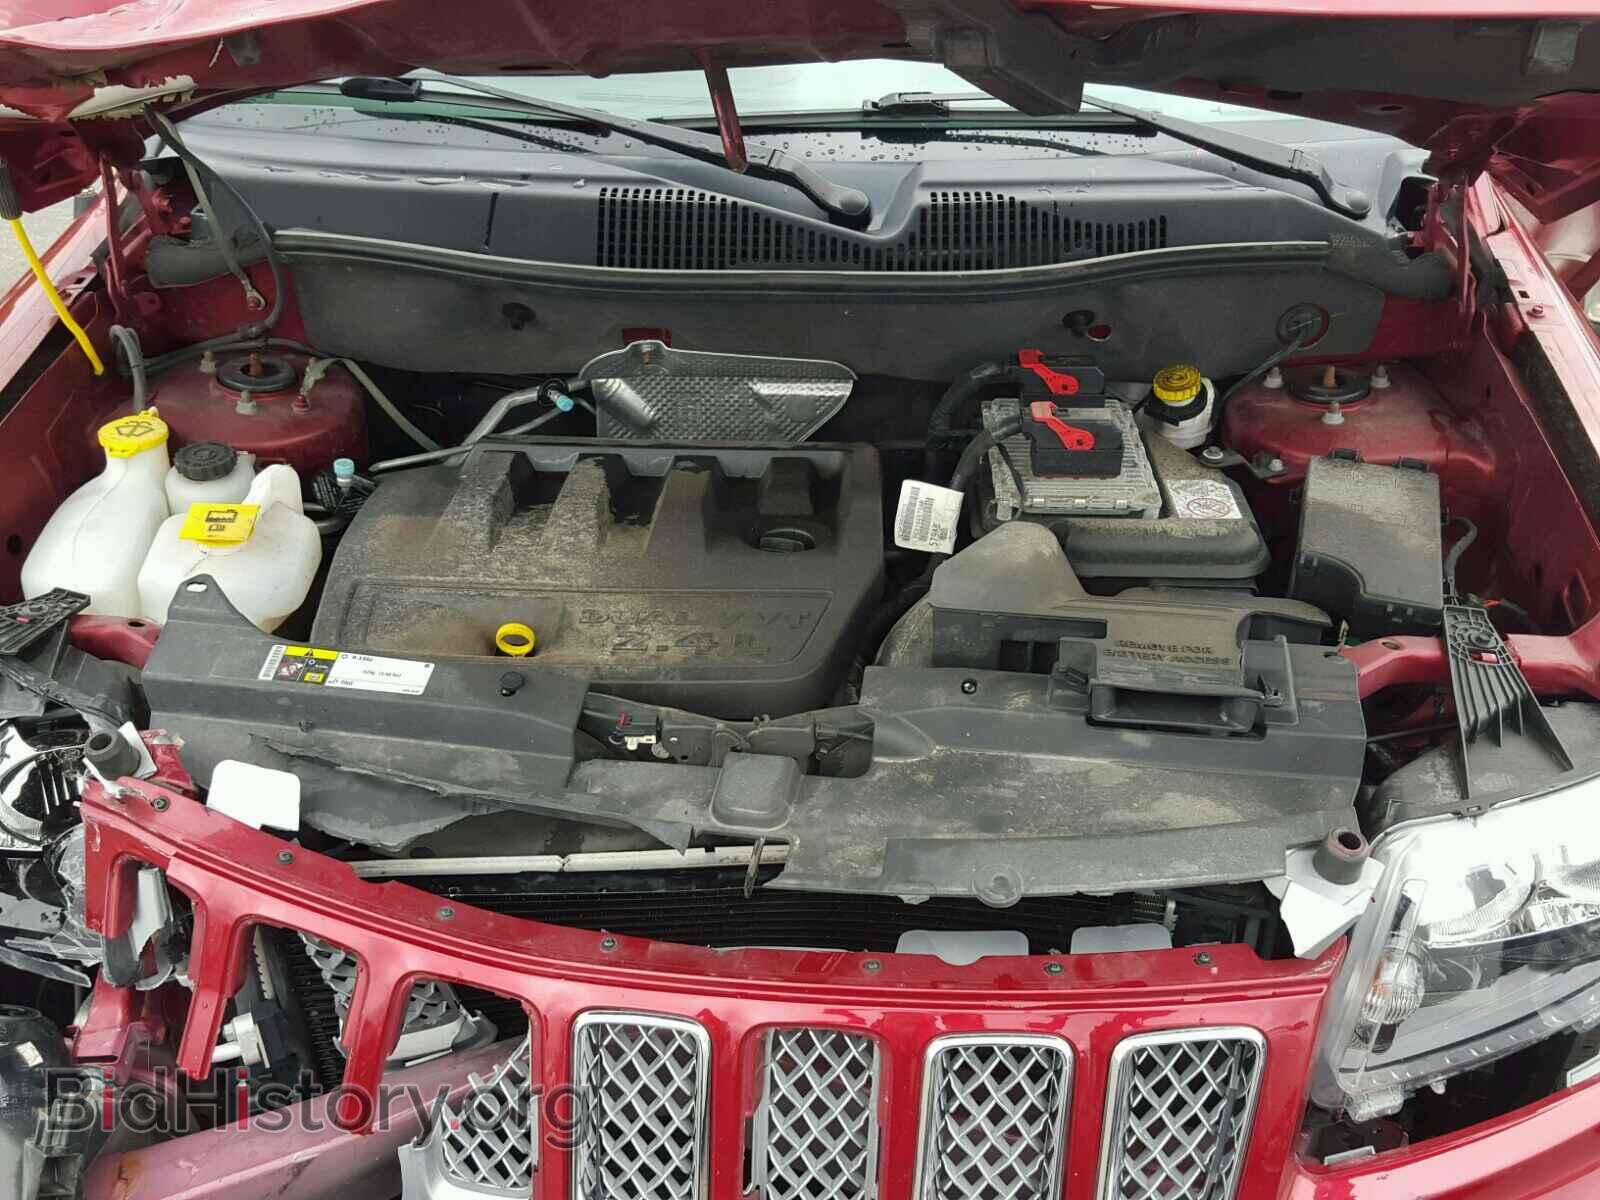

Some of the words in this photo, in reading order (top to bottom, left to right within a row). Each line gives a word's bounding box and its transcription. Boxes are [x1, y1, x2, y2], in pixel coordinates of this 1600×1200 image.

[579, 608, 701, 626] DUAL
[1118, 640, 1178, 652] REMOVE
[1182, 645, 1215, 655] FOR
[1103, 649, 1163, 661] BATTERY
[1169, 655, 1233, 666] ACCESS
